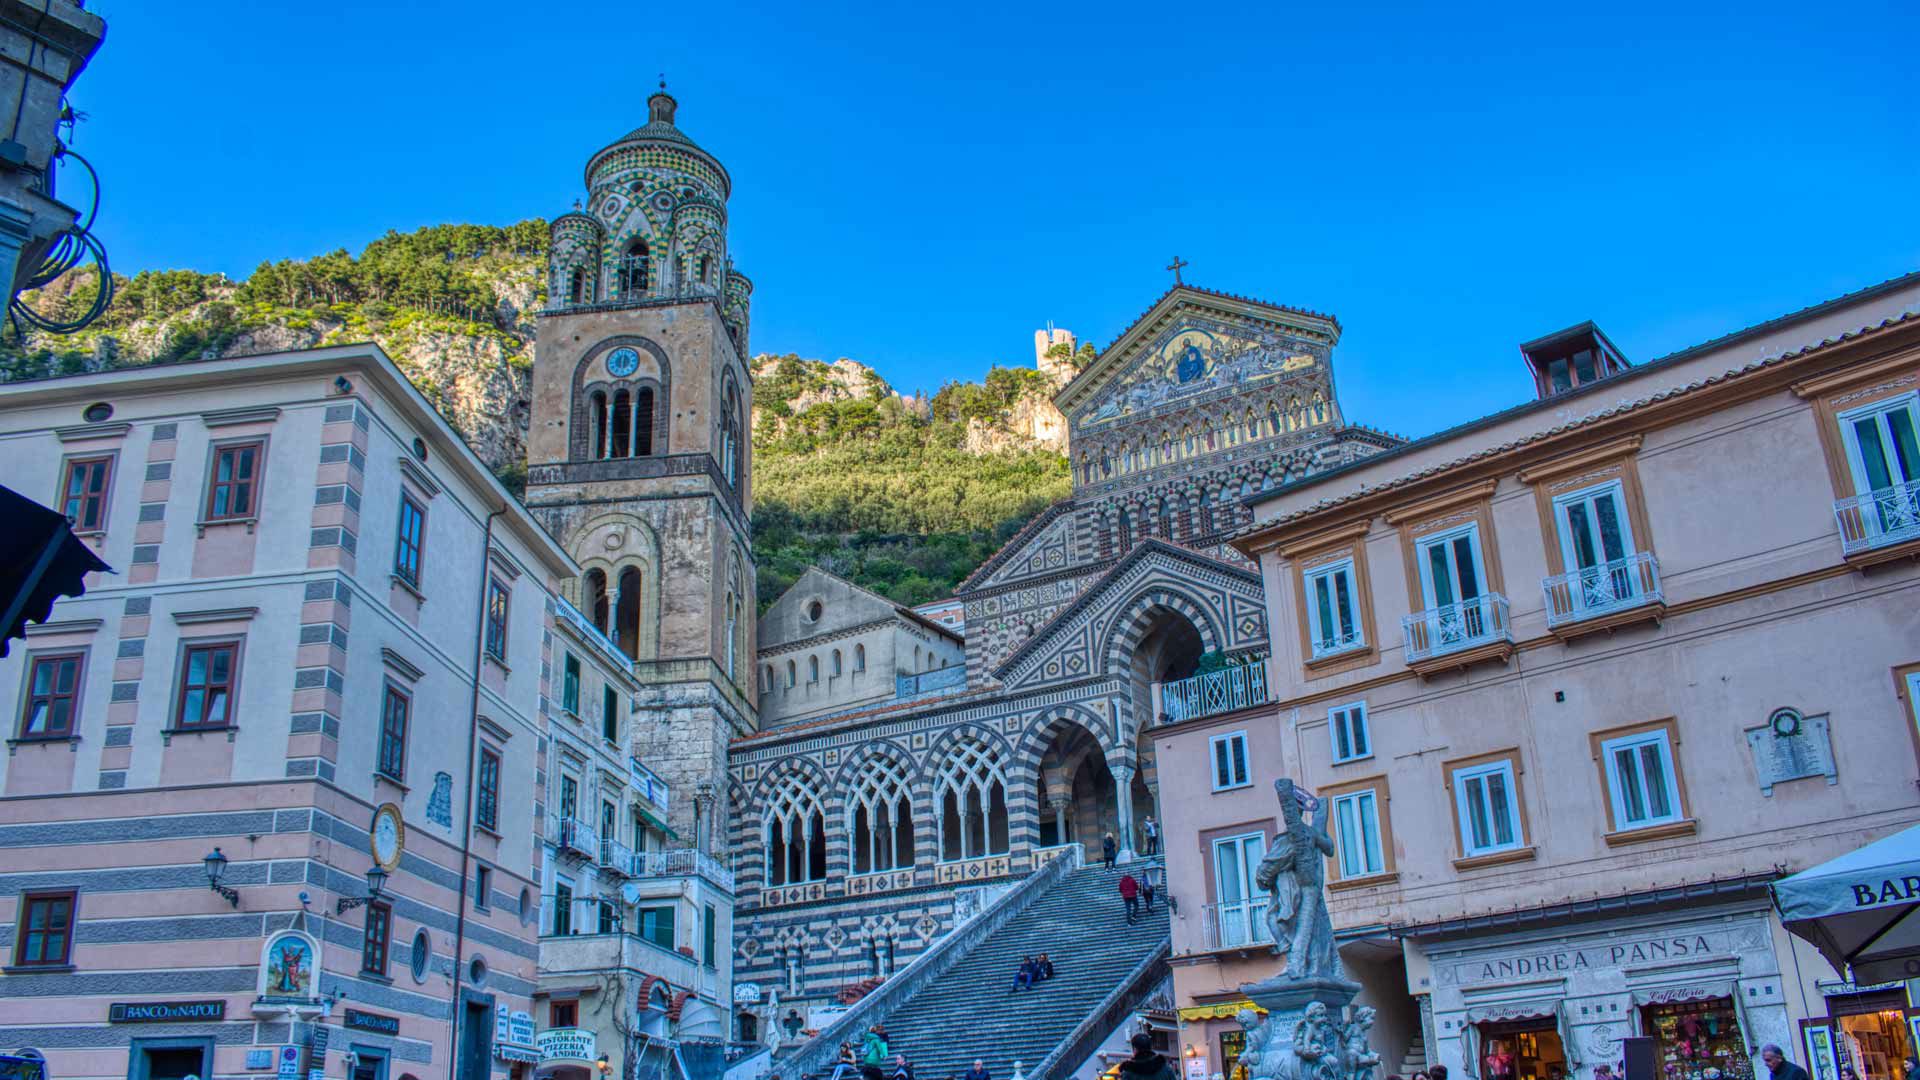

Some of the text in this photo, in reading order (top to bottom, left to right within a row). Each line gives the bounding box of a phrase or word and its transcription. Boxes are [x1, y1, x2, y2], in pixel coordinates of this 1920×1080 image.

[1851, 875, 1920, 907] BAR
[1482, 935, 1711, 980] ANDREA PANSA
[1650, 988, 1706, 1002] Caffetteria
[127, 1006, 168, 1018] BANCO
[178, 1004, 221, 1016] NAPOLI
[1484, 1006, 1534, 1018] Pasticceria
[537, 1035, 593, 1046] RISTORANTE
[543, 1042, 586, 1053] PIZZERIA
[551, 1050, 589, 1059] ANDREA
